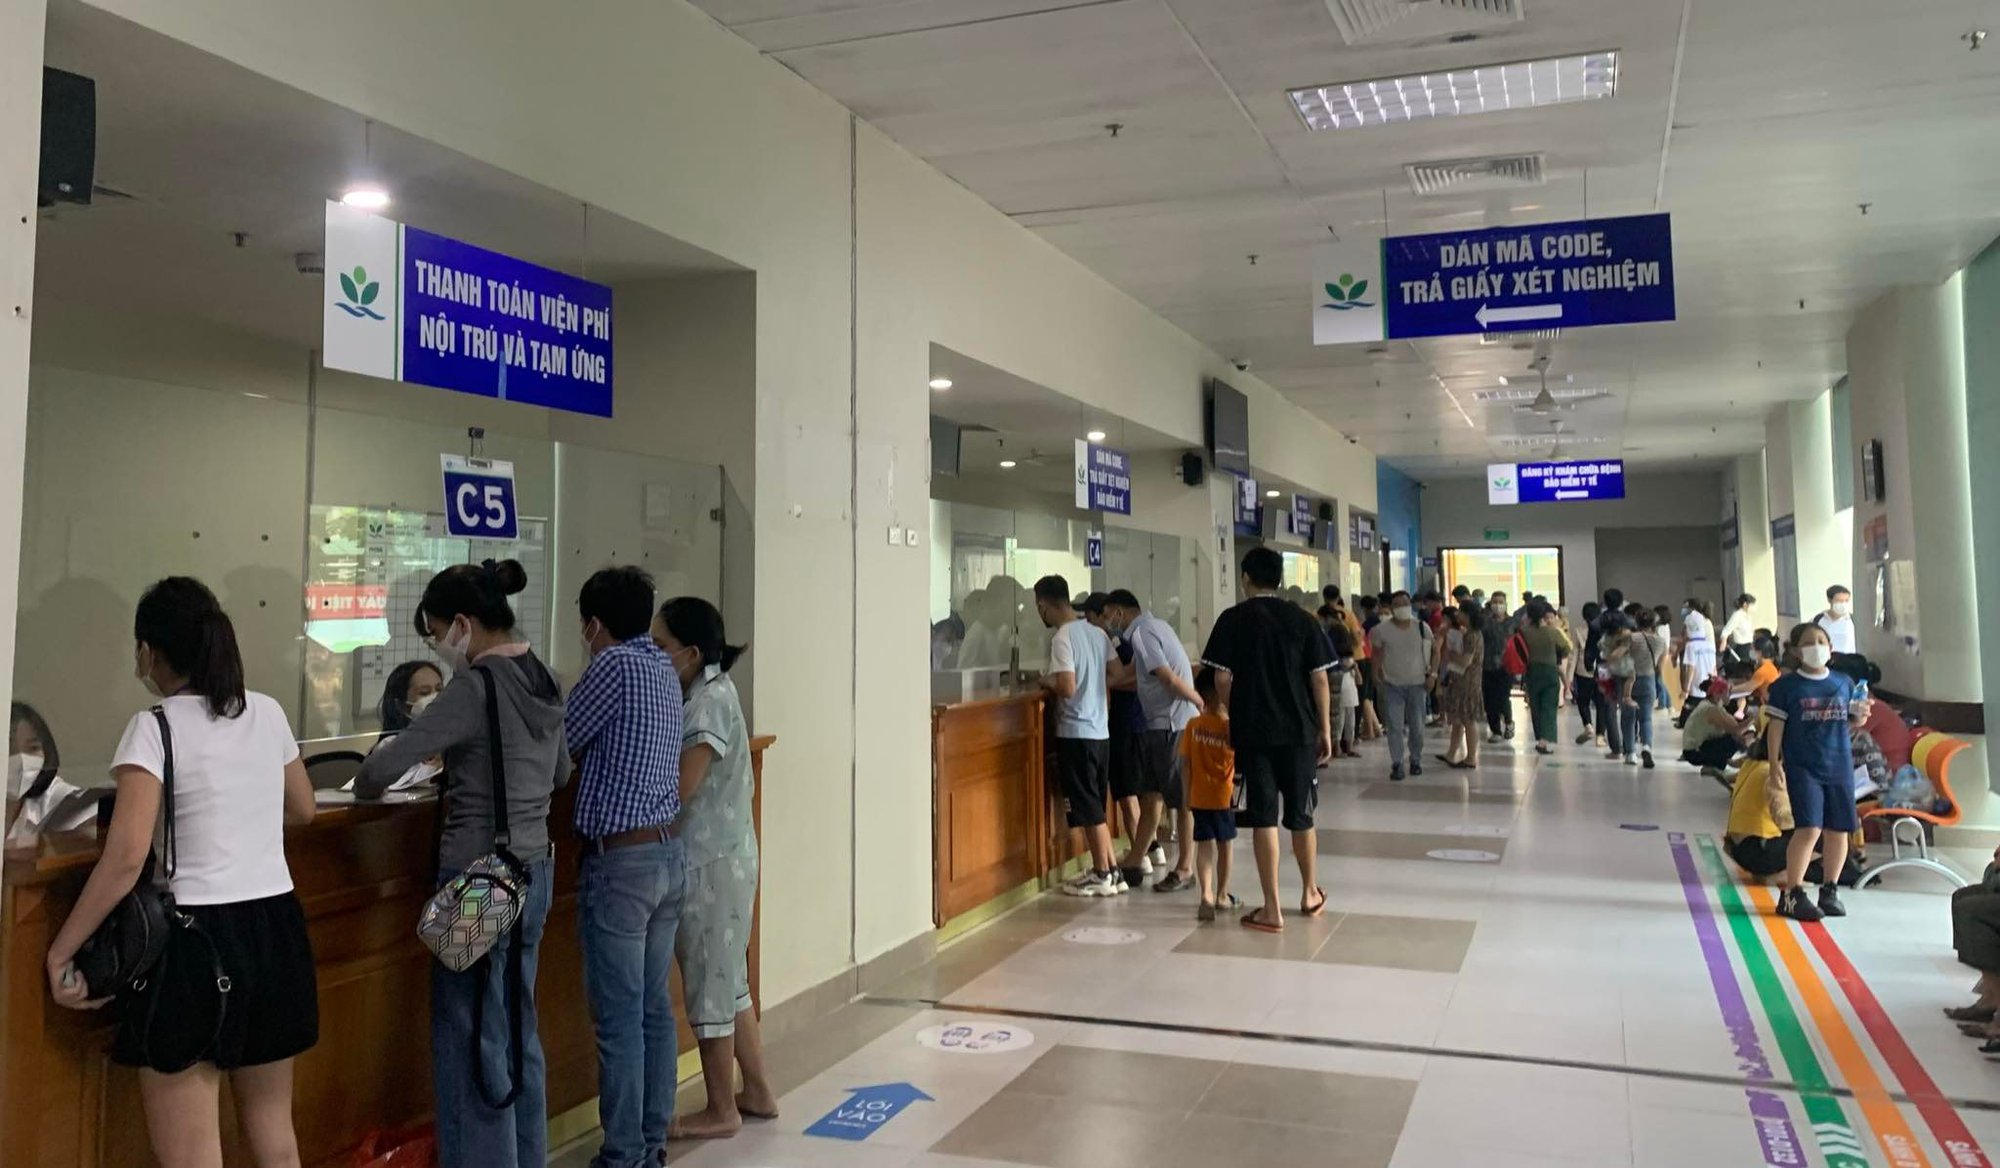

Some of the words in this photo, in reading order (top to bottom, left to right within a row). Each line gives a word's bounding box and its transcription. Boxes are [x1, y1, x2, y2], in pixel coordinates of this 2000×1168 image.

[1440, 239, 1489, 269] DÁN
[1496, 234, 1535, 264] MÃ
[1542, 231, 1612, 260] CODE,
[415, 259, 481, 308] THANH
[487, 280, 534, 321] TOÁN
[540, 294, 578, 335] VIỆN
[583, 307, 609, 341] PHÍ
[1400, 271, 1444, 304] TRẢ
[1451, 265, 1504, 301] GIẤY
[1512, 265, 1555, 296] XÉT
[1563, 258, 1660, 292] NGHIỆM
[420, 312, 455, 357] NỘI
[462, 324, 498, 362] TRÚ
[503, 330, 526, 368] VÀ
[530, 340, 567, 379] TẠM
[572, 344, 605, 384] ỨNG
[457, 482, 506, 529] C5
[1089, 542, 1100, 563] C4
